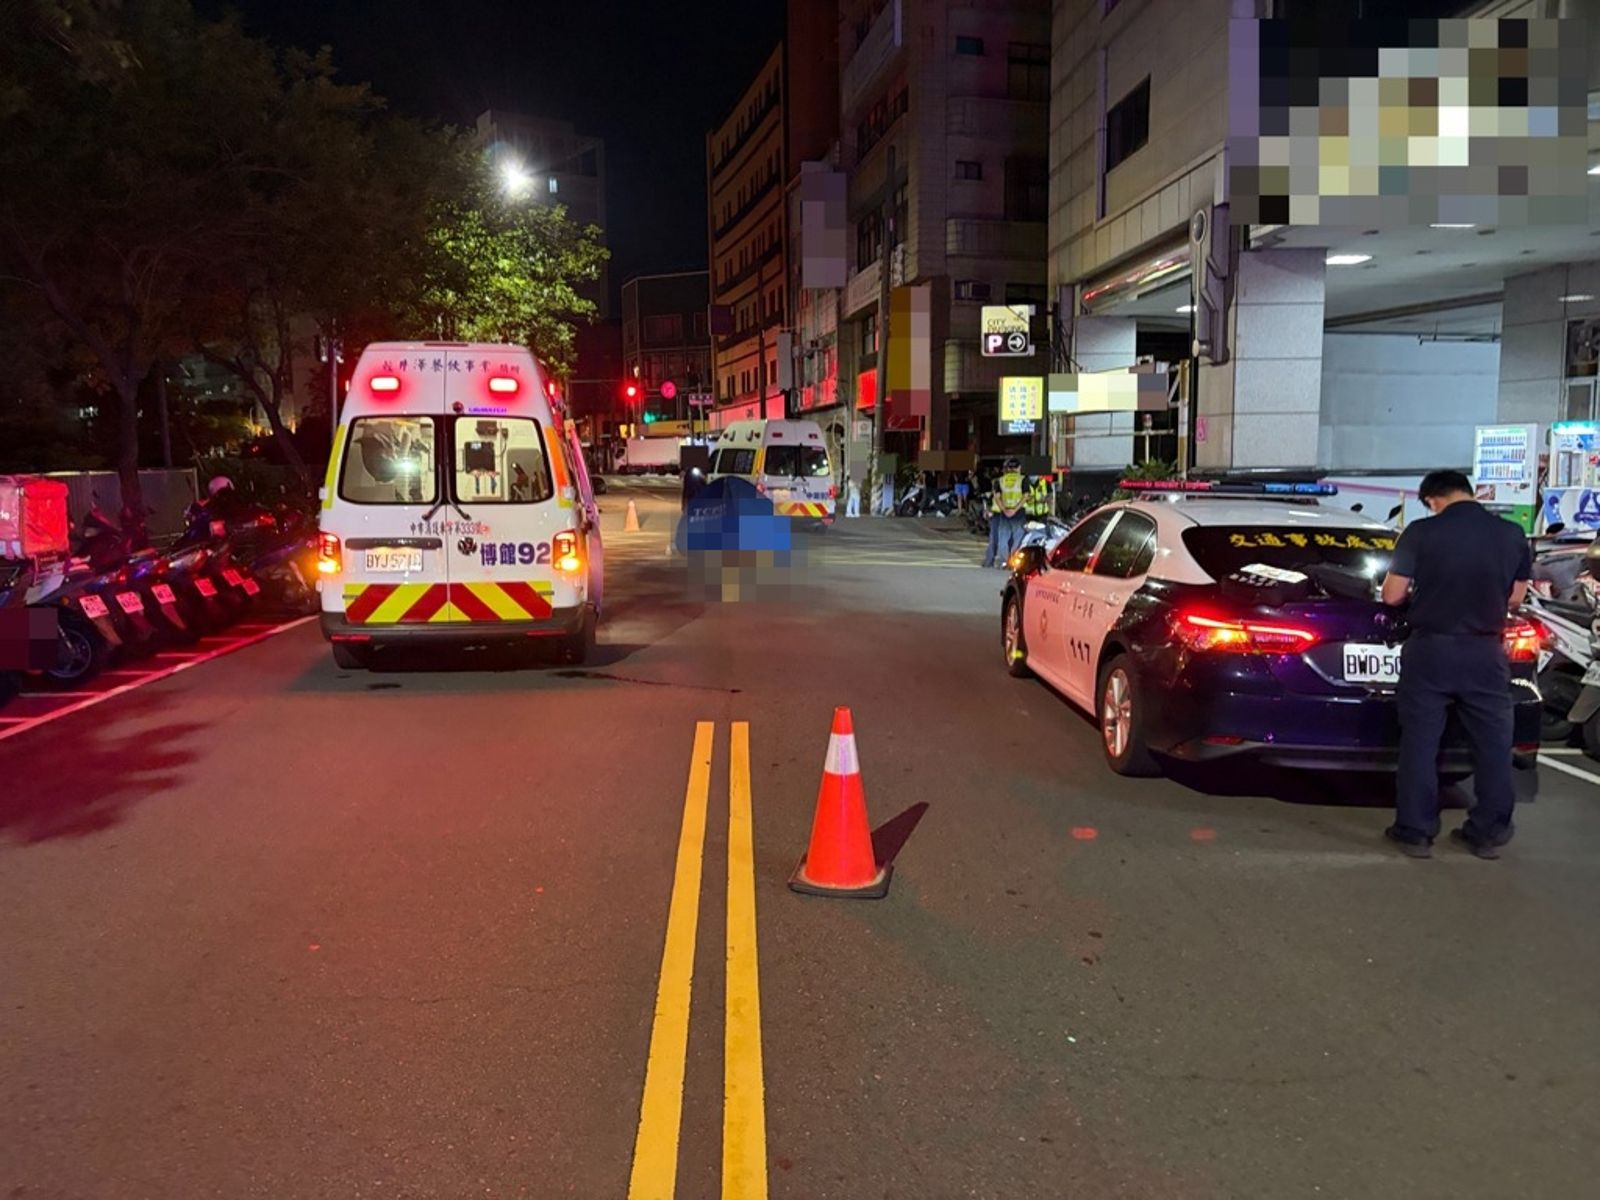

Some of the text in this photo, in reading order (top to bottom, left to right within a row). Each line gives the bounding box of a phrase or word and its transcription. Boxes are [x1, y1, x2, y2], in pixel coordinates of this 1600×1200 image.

[988, 335, 1003, 353] P
[480, 541, 551, 567] 博館92
[1070, 637, 1090, 665] 117
